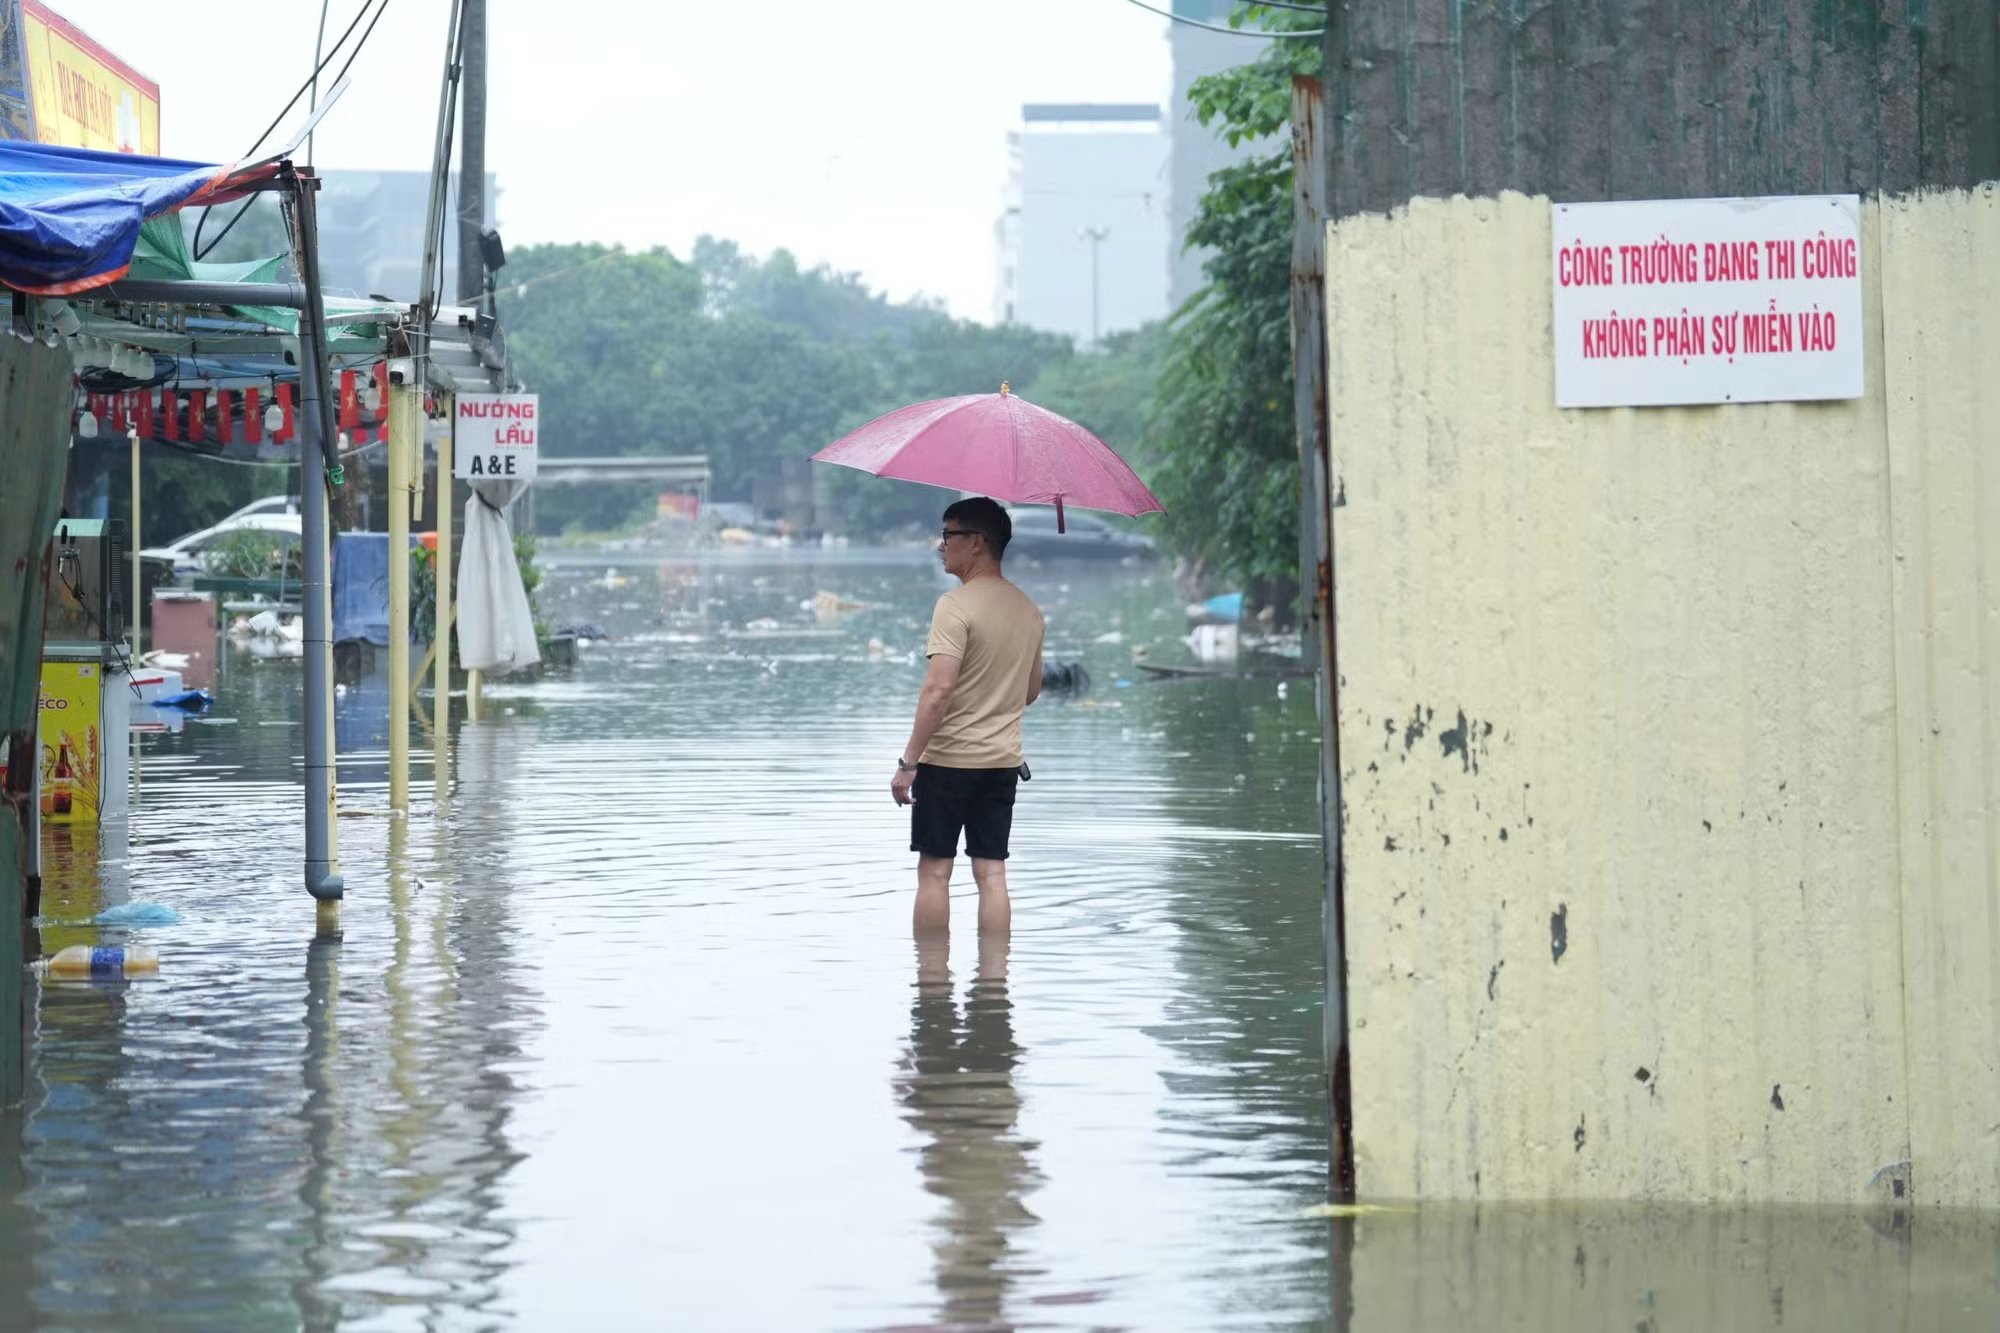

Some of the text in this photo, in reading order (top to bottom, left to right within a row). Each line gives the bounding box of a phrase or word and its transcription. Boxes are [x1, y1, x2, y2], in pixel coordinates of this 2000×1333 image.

[1559, 230, 1857, 287] CÔNG TRƯỜNG ĐANG THI CÔNG
[1583, 299, 1836, 365] KHÔNG PHẬN SỰ MIỄN VÀO
[459, 398, 535, 418] NƯỚNG
[495, 421, 534, 444] LẨU
